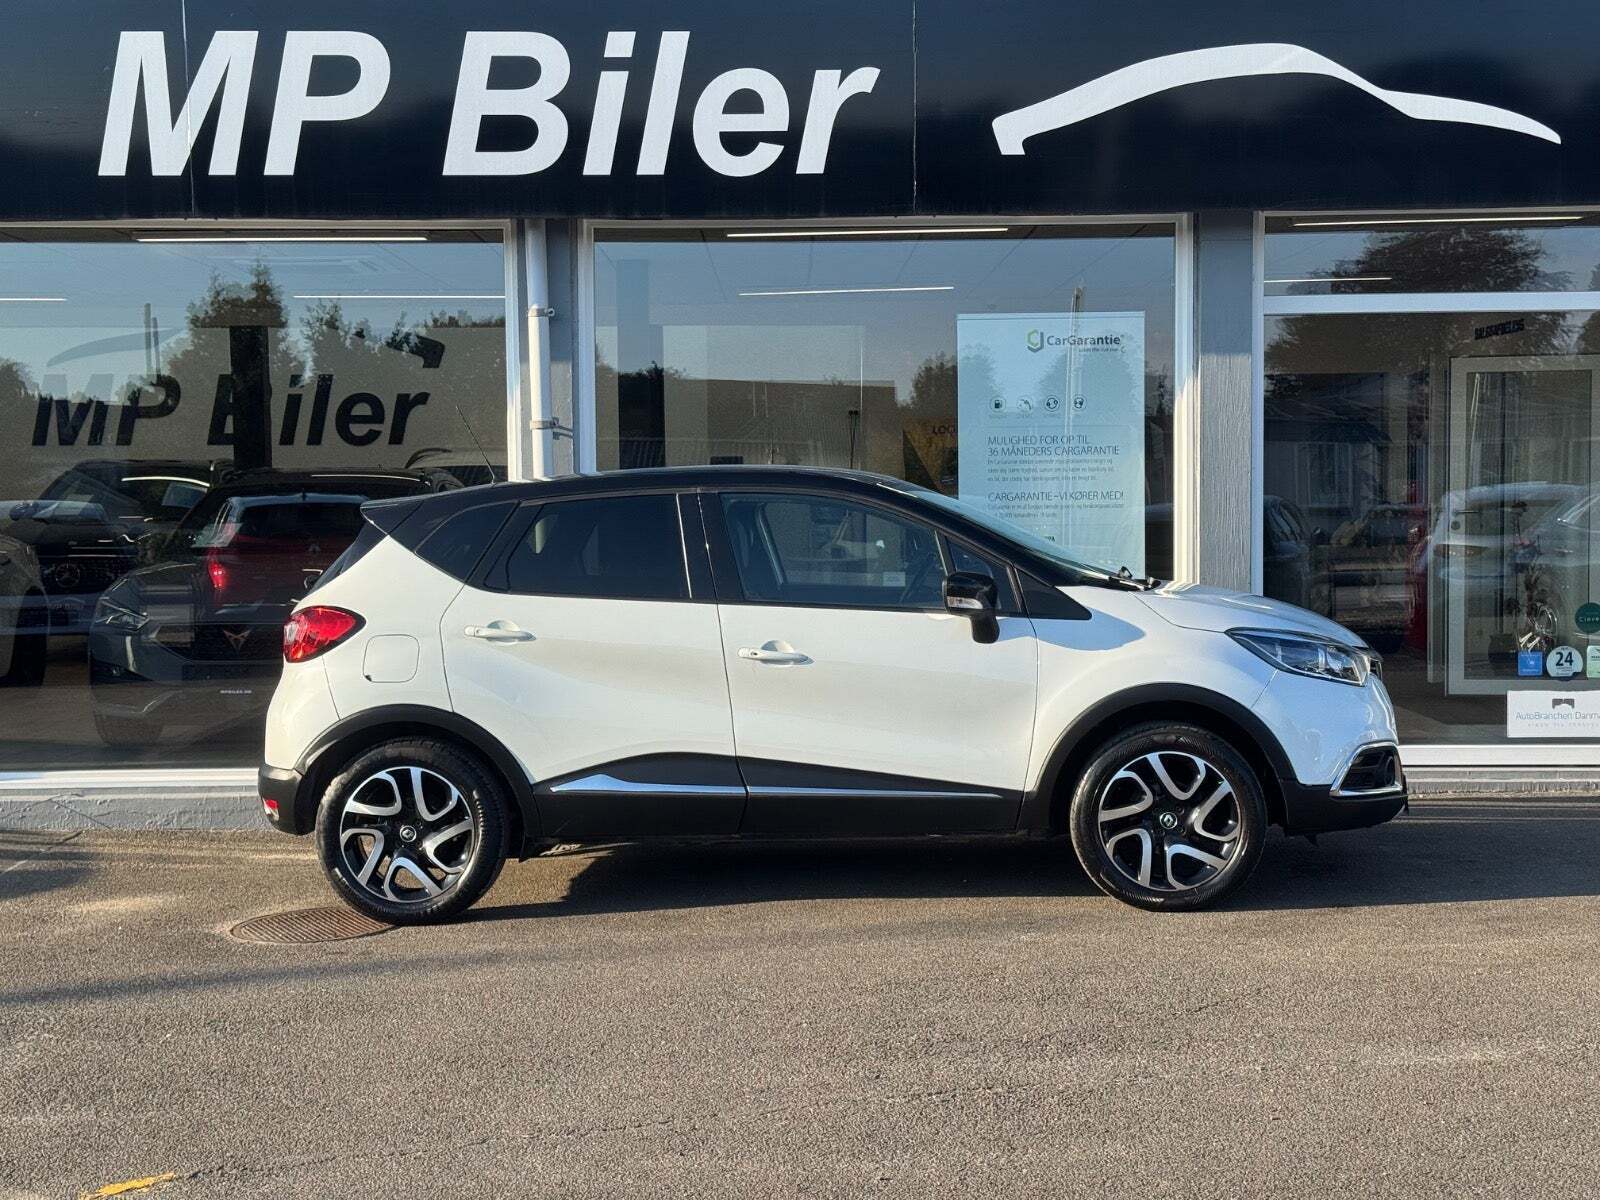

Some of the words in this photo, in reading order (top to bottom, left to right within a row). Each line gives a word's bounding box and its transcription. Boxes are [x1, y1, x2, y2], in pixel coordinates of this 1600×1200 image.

[97, 29, 391, 176] MP
[441, 29, 881, 178] Biler
[1046, 333, 1121, 346] CarGarantie
[31, 373, 181, 447] MP
[987, 434, 1038, 446] MULIGHED
[1039, 434, 1059, 445] FOR
[1060, 434, 1075, 445] OP
[1076, 434, 1090, 445] TIL
[987, 447, 999, 457] 36
[1000, 445, 1052, 457] MÅNEDERS
[1053, 445, 1120, 456] CARGARANTIE
[1555, 651, 1574, 667] 24
